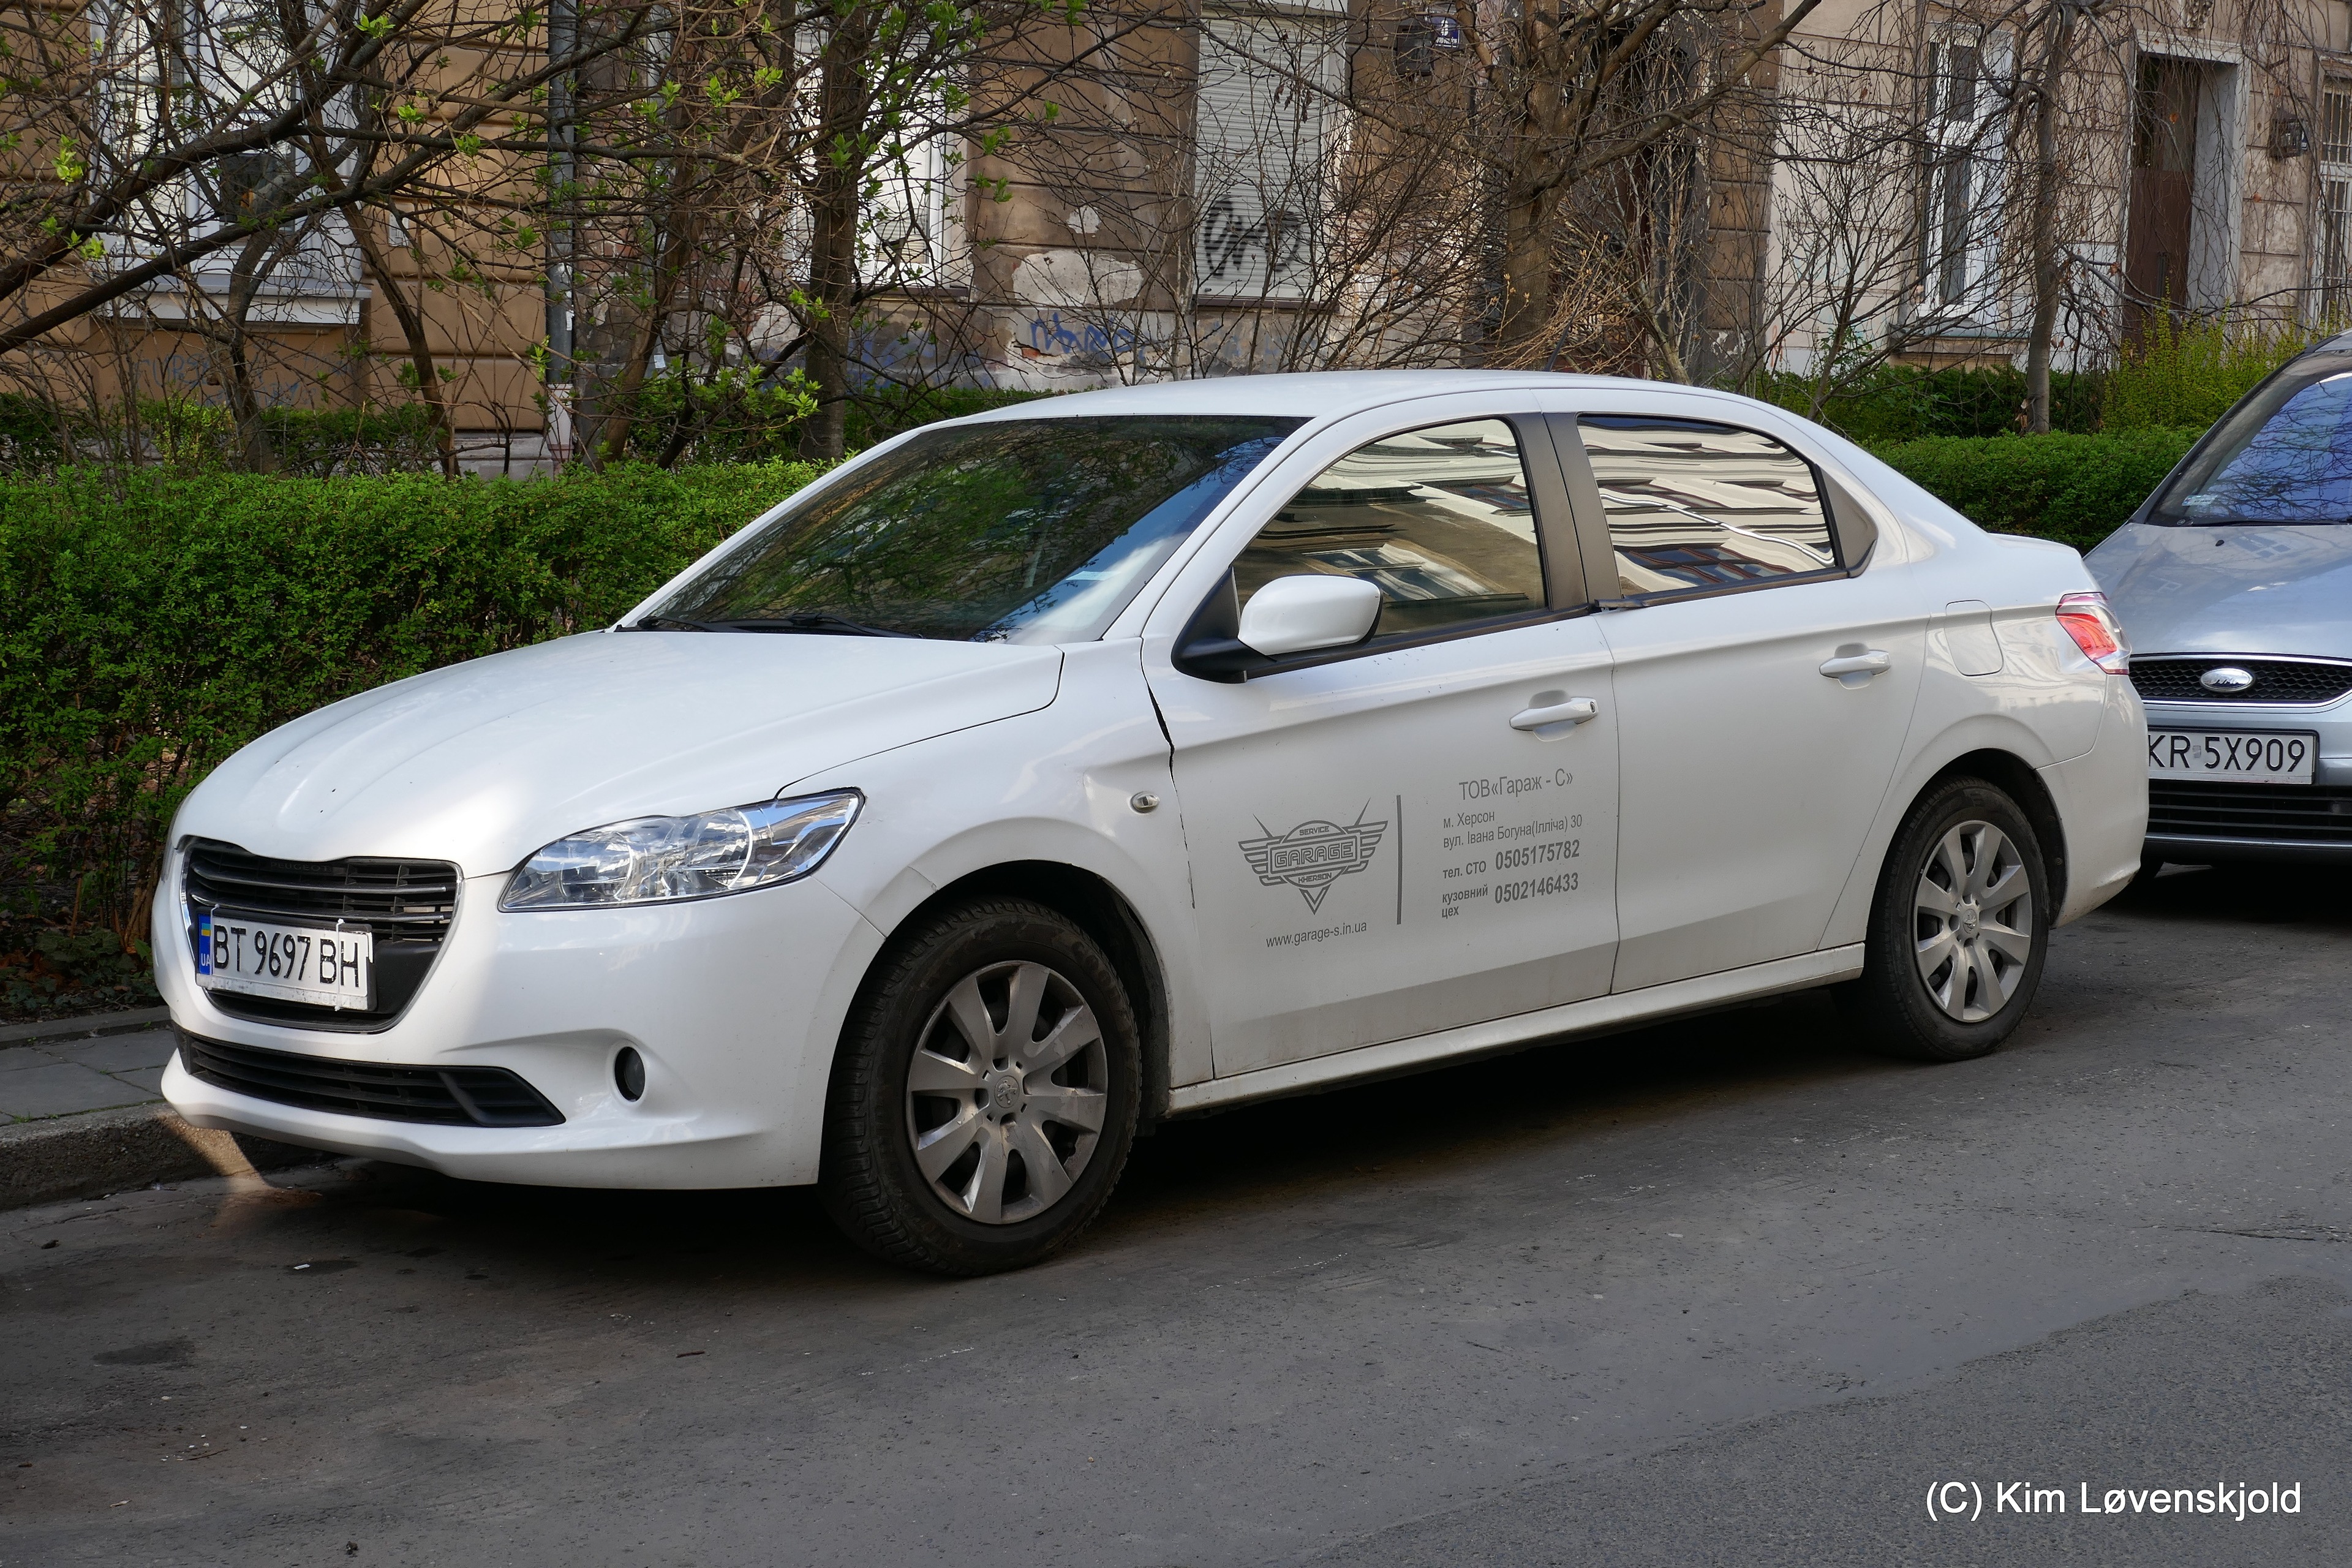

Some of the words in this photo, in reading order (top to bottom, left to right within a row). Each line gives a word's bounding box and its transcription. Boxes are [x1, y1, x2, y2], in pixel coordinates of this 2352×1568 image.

[2149, 734, 2190, 769] KR
[2204, 736, 2305, 772] 5X909
[1299, 825, 1330, 836] SERVICE
[1443, 818, 1453, 829] м.
[1457, 811, 1495, 828] Херсон
[1443, 835, 1464, 851] вул.
[1467, 830, 1494, 845] Івана
[1570, 813, 1583, 828] 30
[270, 861, 330, 872] PEUGEOT
[1274, 841, 1354, 868] GARAGE
[1442, 866, 1463, 879] тел.
[1495, 839, 1580, 870] 0505175782
[1298, 872, 1332, 884] KHERSON
[1442, 884, 1488, 905] кузовний
[1494, 872, 1579, 904] 0502146433
[1441, 906, 1460, 919] цех
[1265, 921, 1367, 948] www.garage-s.in.ua
[200, 952, 212, 967] UA
[214, 924, 247, 971] BT
[254, 930, 311, 981] 9697
[320, 938, 359, 987] BH
